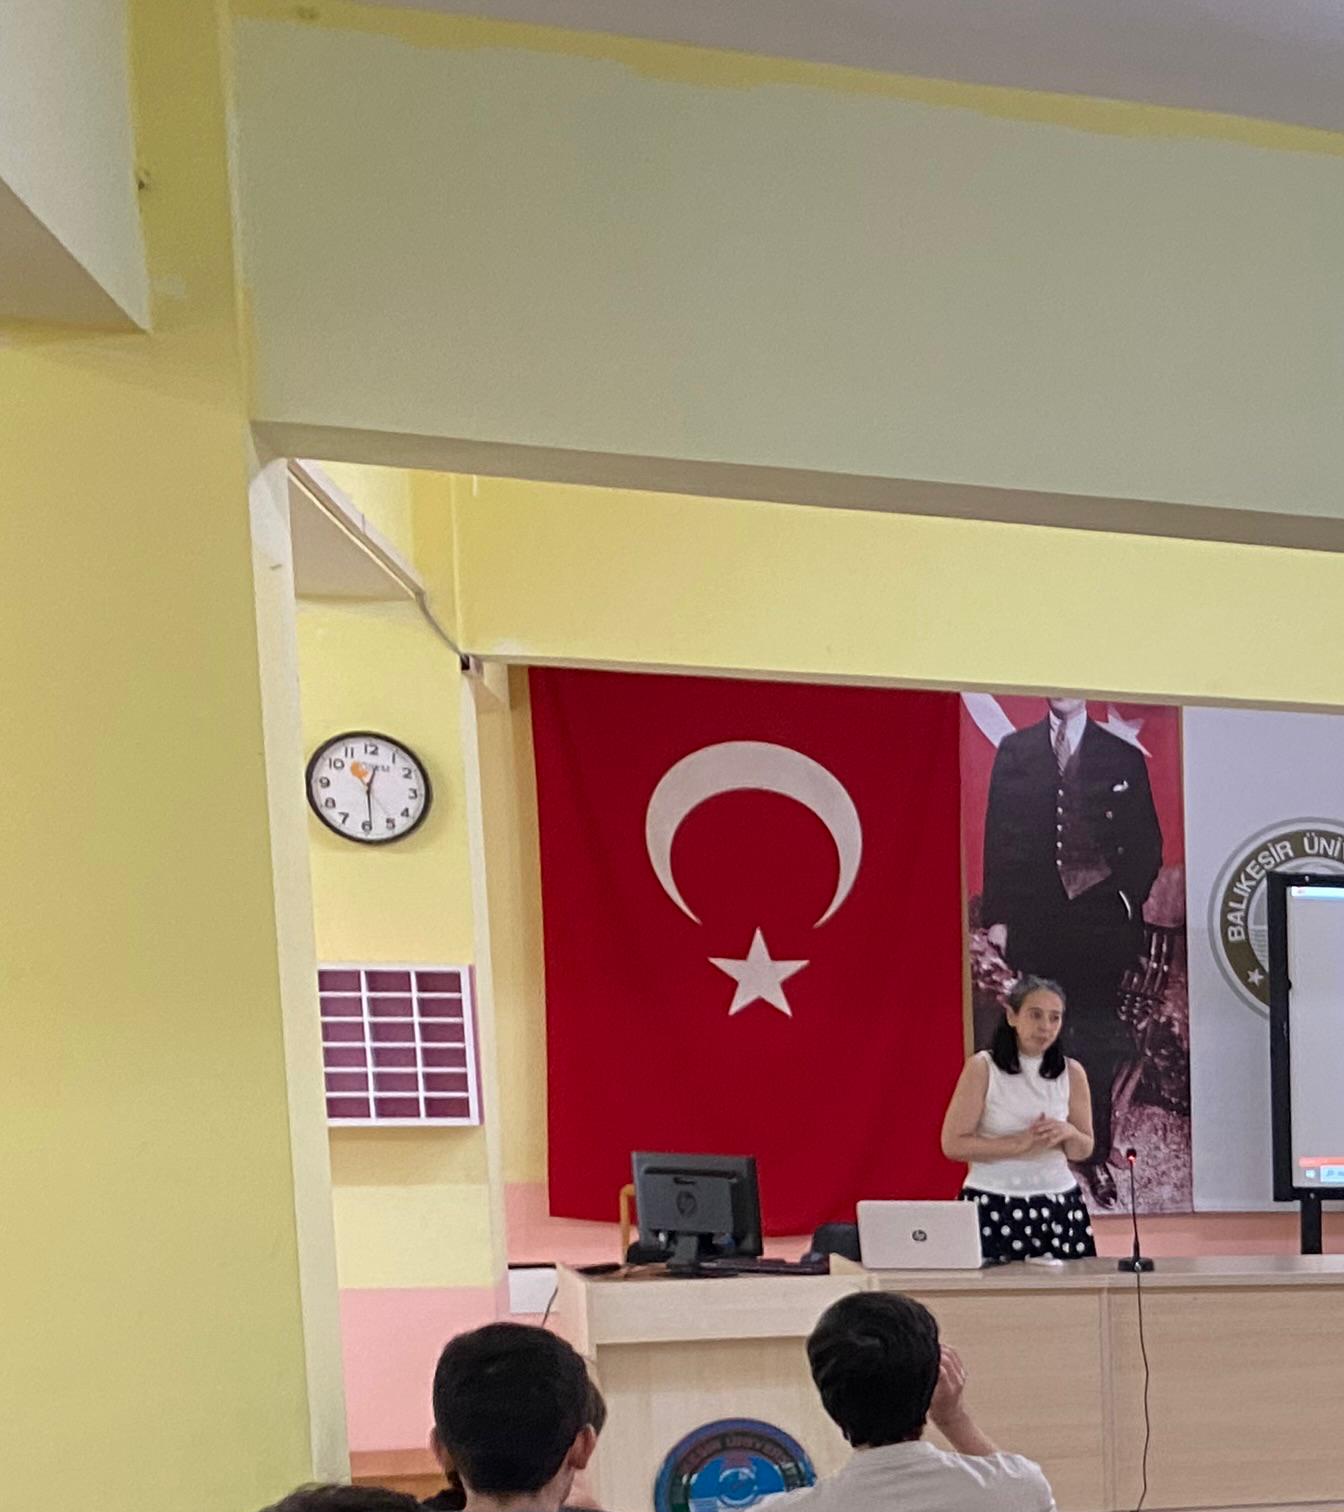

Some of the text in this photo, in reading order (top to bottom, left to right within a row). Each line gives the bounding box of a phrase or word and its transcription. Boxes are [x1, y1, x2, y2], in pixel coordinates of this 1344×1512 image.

[345, 746, 354, 758] 11
[364, 743, 379, 756] 12
[328, 757, 345, 770] 10
[391, 752, 396, 764] 1
[402, 767, 413, 779] 2
[319, 776, 330, 789] 9
[408, 787, 418, 800] 3
[324, 797, 336, 809] 8
[338, 811, 350, 825] 7
[400, 807, 409, 818] 4
[361, 820, 373, 832] 6
[385, 818, 396, 830] 5
[1227, 840, 1295, 943] BALIKESİR
